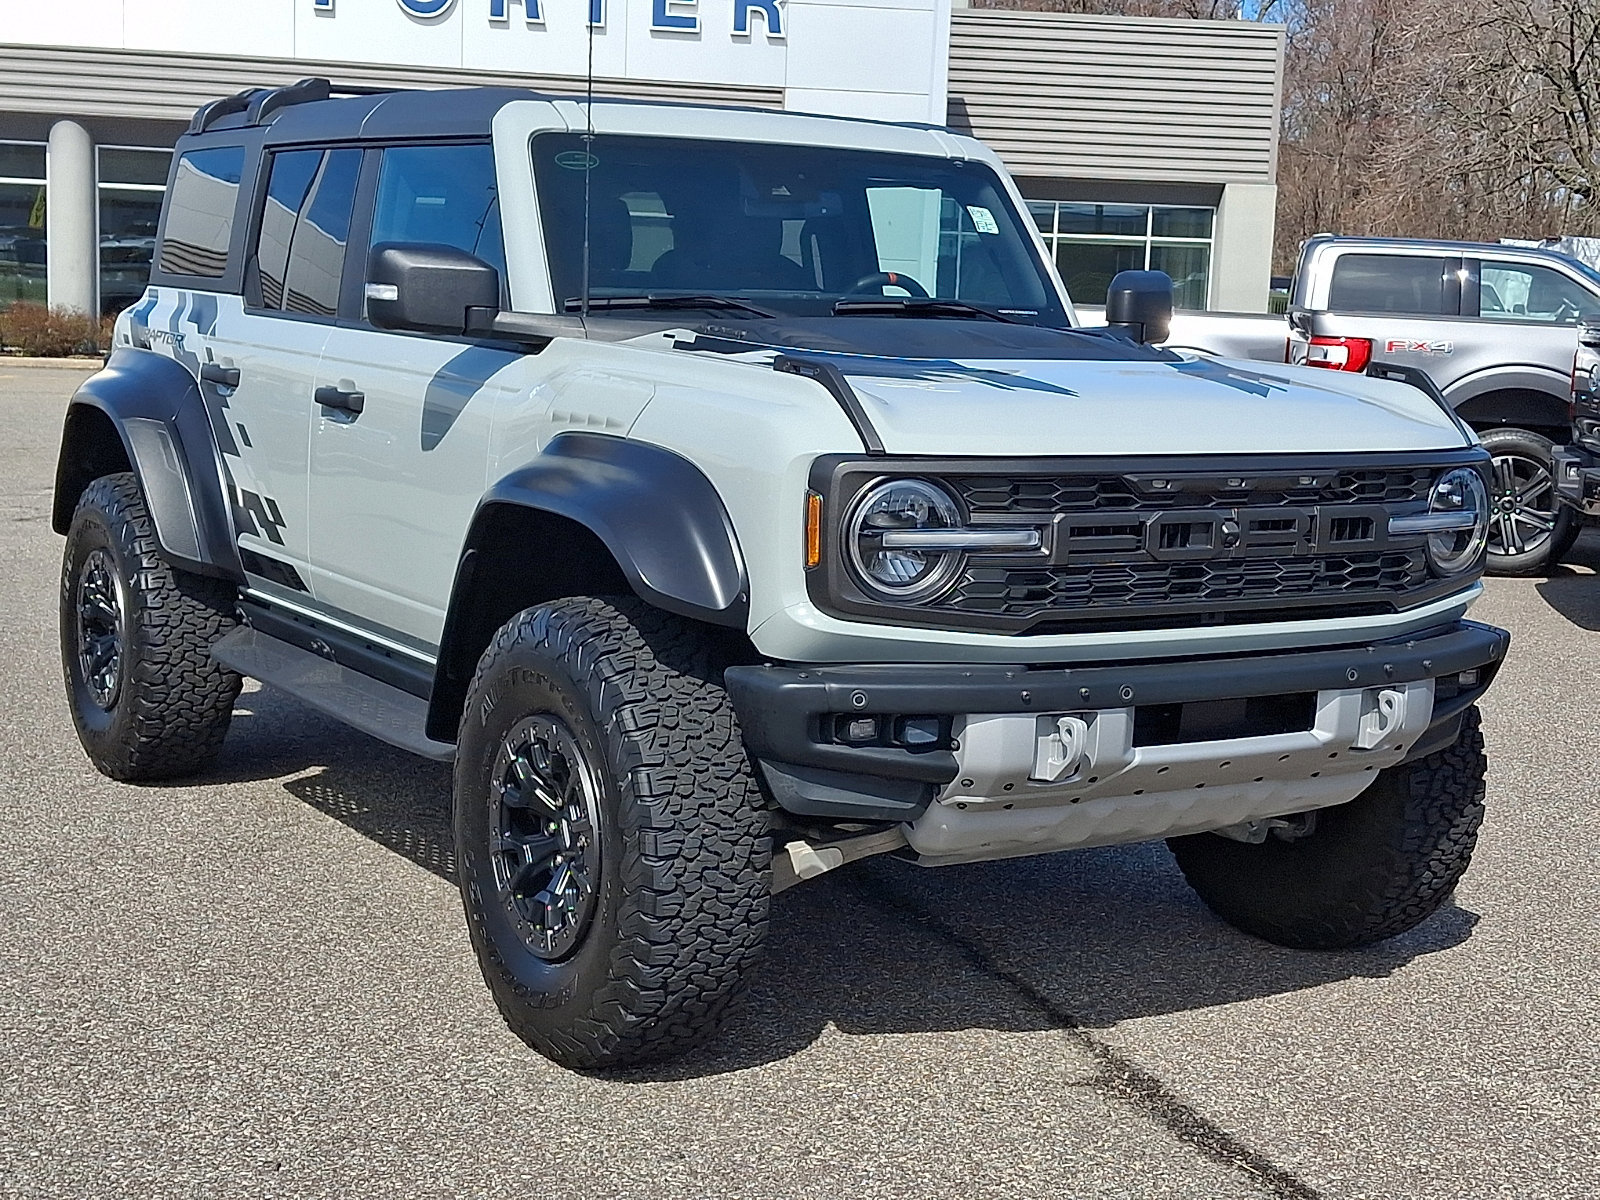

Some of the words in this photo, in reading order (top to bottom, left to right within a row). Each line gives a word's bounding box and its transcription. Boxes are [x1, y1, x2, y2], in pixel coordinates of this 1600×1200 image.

[144, 328, 186, 350] RAPTOR
[1385, 339, 1453, 354] FX4
[1053, 505, 1389, 564] FORD
